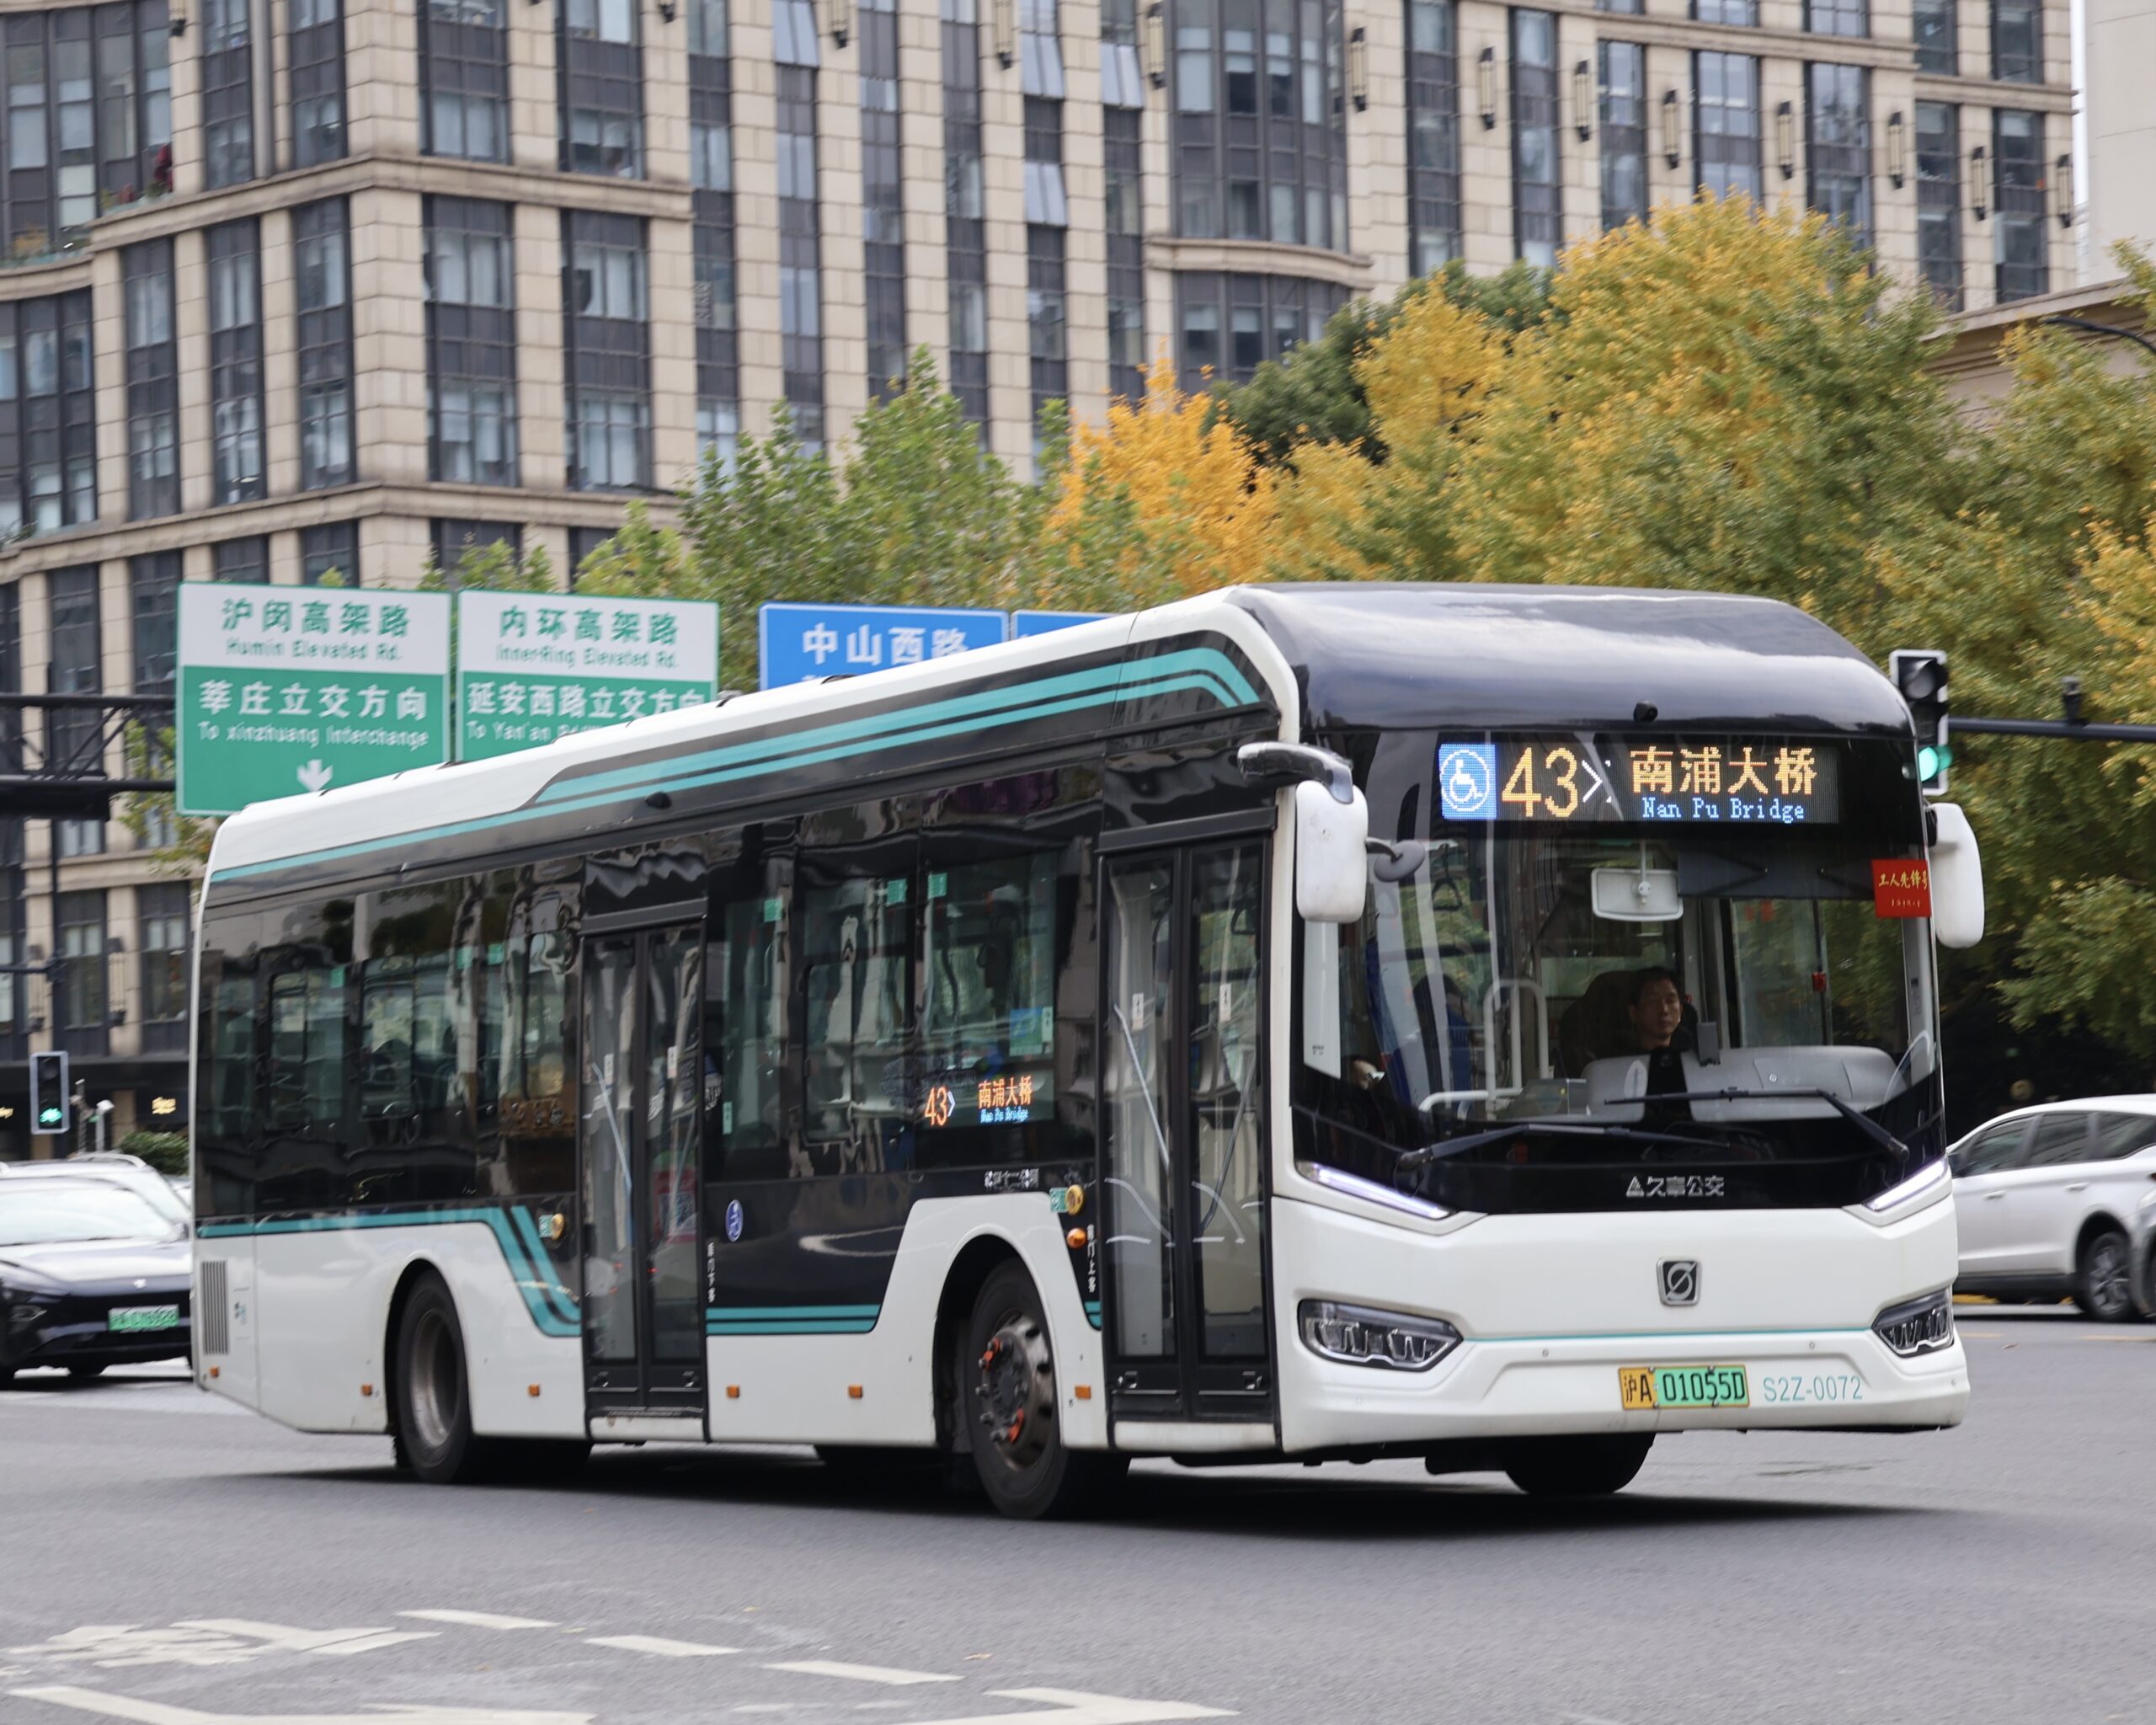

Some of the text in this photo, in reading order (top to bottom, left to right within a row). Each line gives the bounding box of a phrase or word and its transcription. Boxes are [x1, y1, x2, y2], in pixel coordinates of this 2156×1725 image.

[221, 597, 410, 638] 沪闵高架路
[499, 605, 679, 646] 内环高架路
[226, 638, 403, 661] Humin Elevated Rd.
[583, 648, 649, 668] Elevated
[655, 651, 680, 669] Rd.
[803, 622, 969, 666] 中山西路
[198, 680, 427, 720] 莘庄立交方向
[467, 681, 705, 719] 延安西路立交方向
[197, 720, 219, 740] To
[326, 726, 430, 751] Interchange
[466, 721, 487, 741] To
[494, 722, 552, 742] Yan'an
[1502, 746, 1578, 817] 43
[1630, 745, 1817, 794] 南浦大桥
[1642, 797, 1804, 824] Nan Pu Bridge
[1878, 868, 1928, 889] 工人先锋号
[925, 1085, 948, 1126] 43
[978, 1076, 1033, 1108] 南浦大桥
[1763, 1375, 1863, 1402] S2Z-0072
